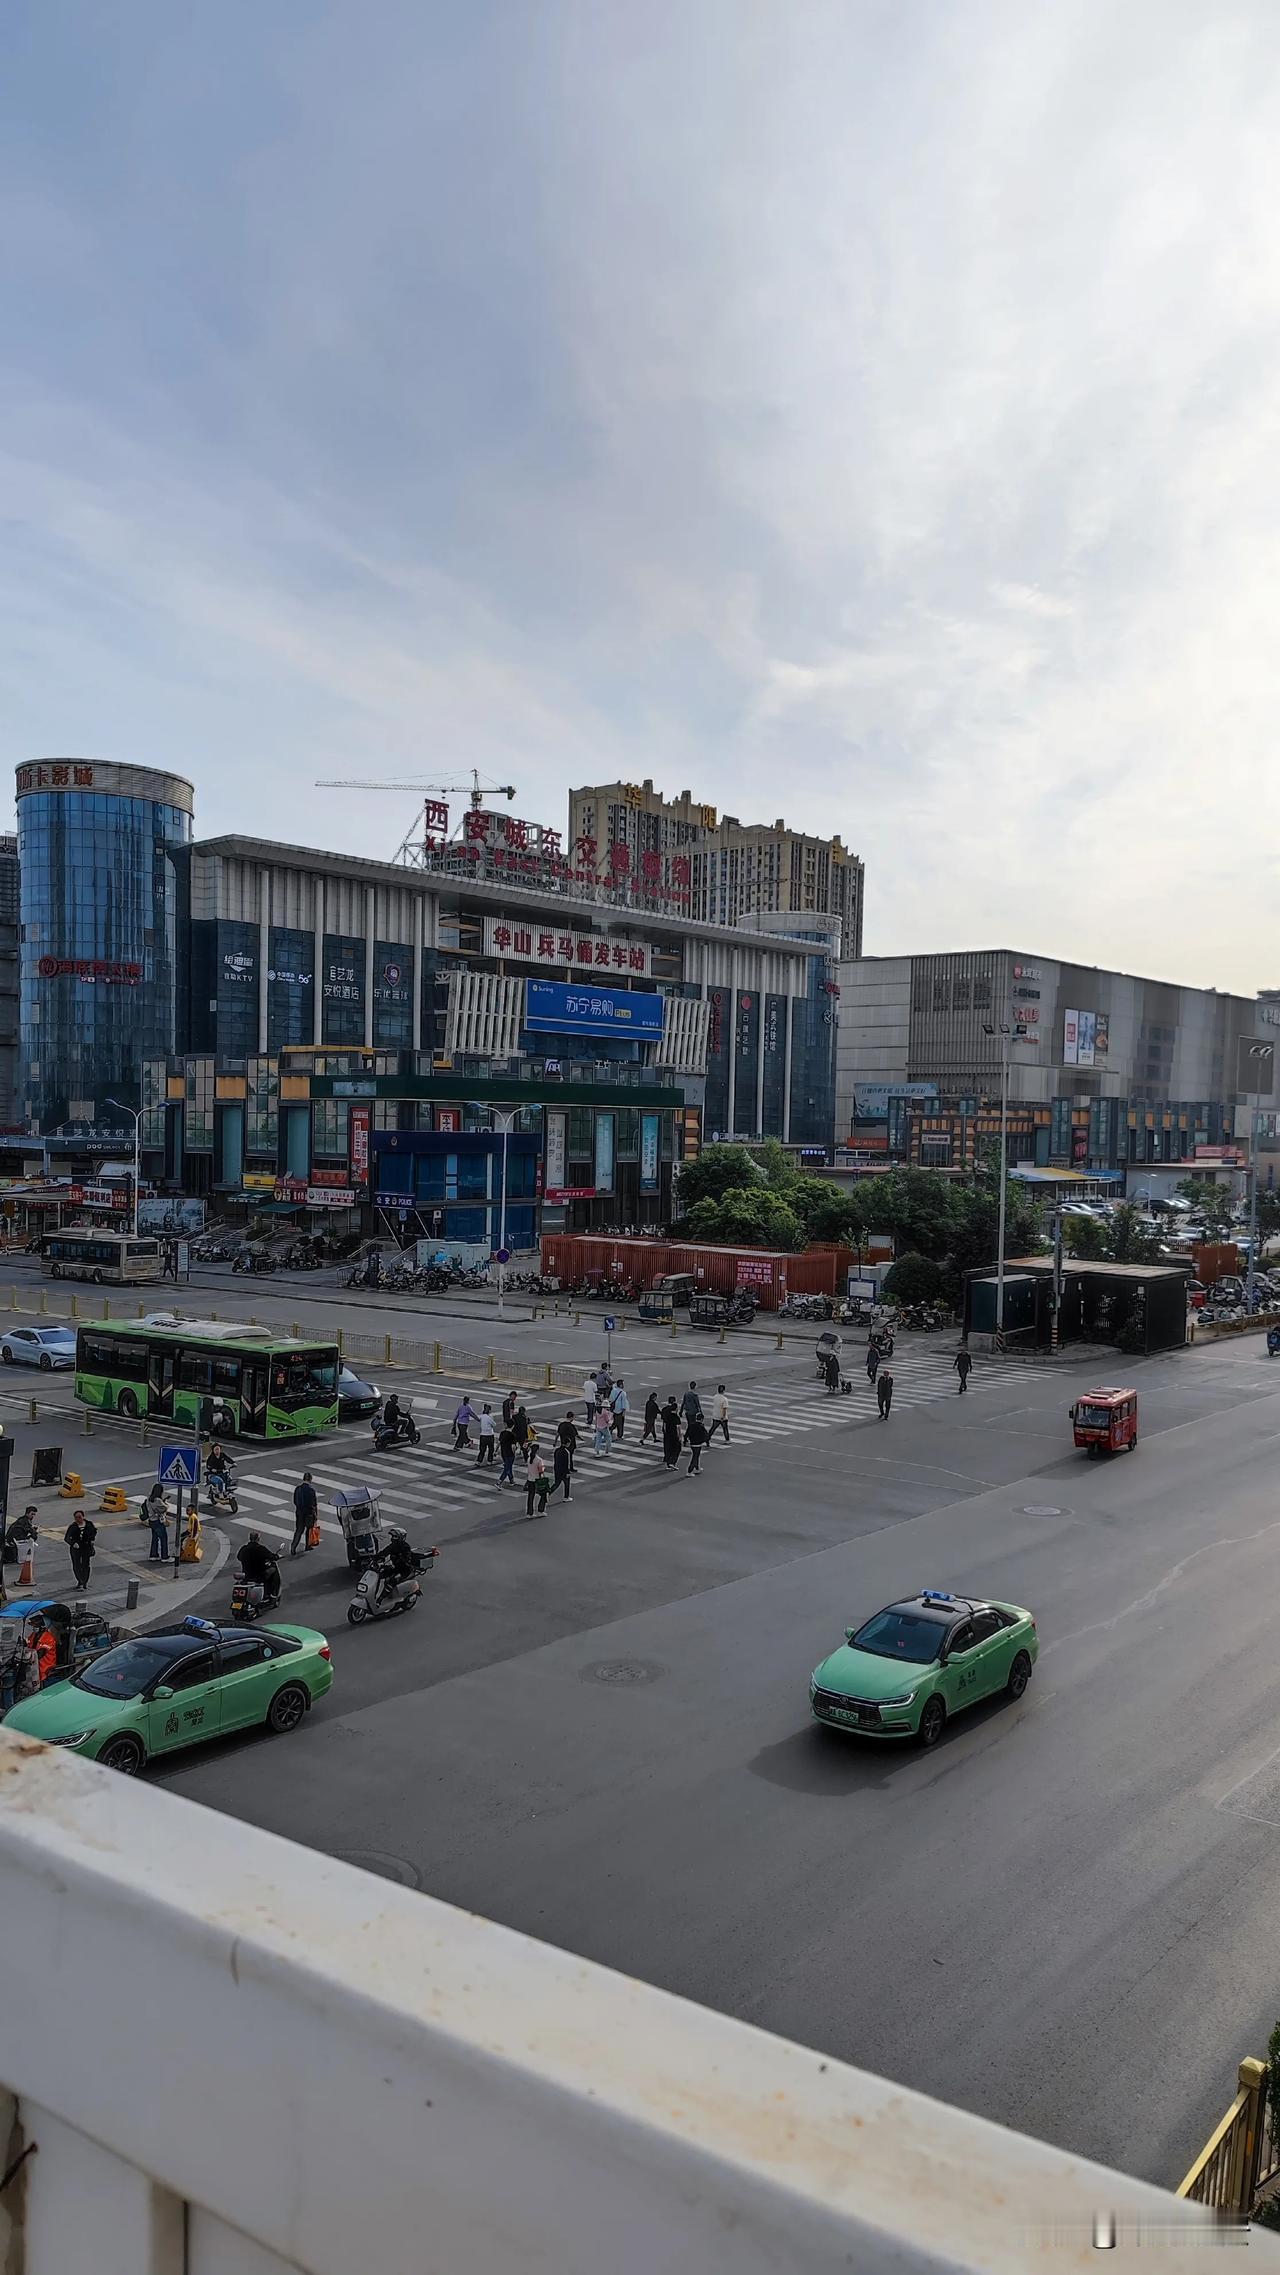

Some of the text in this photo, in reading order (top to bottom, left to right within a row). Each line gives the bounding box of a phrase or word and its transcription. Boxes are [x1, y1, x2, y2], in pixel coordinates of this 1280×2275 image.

[566, 995, 614, 1017] 苏宁易购
[398, 1198, 413, 1206] POLICE
